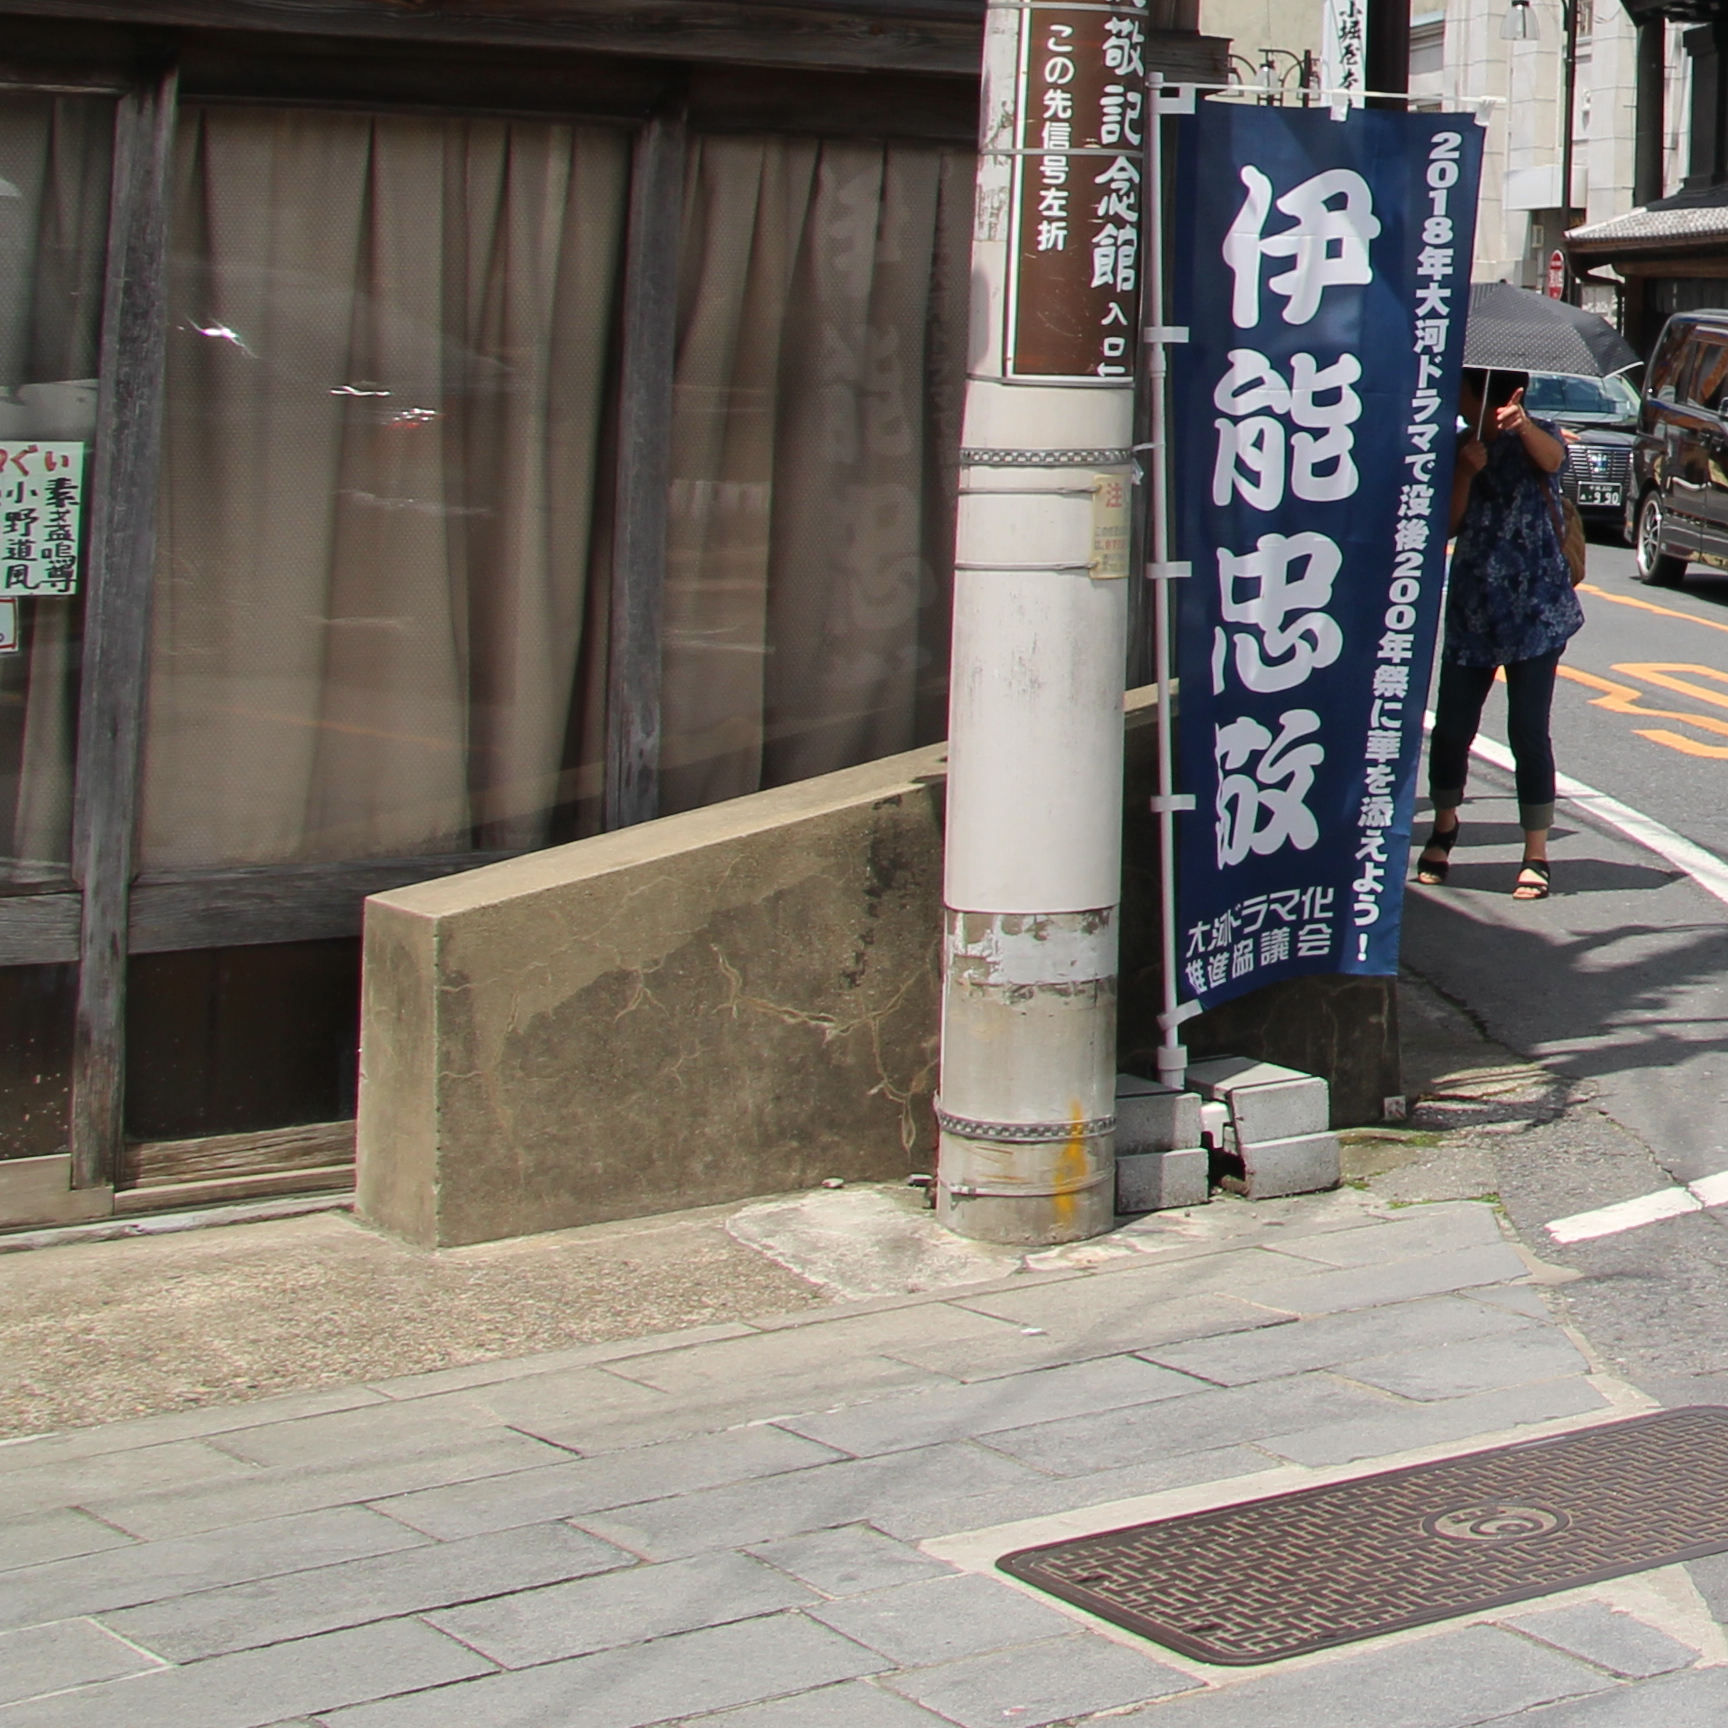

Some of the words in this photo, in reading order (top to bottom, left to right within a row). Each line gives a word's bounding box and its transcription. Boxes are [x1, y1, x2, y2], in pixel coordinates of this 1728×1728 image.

[1037, 24, 1076, 252] この先信号左折
[1100, 301, 1128, 358] 入口
[1212, 164, 1382, 872] 伊能忠敬
[1185, 885, 1335, 958] 大河ドラマ化
[1185, 922, 1334, 995] 推進協議会
